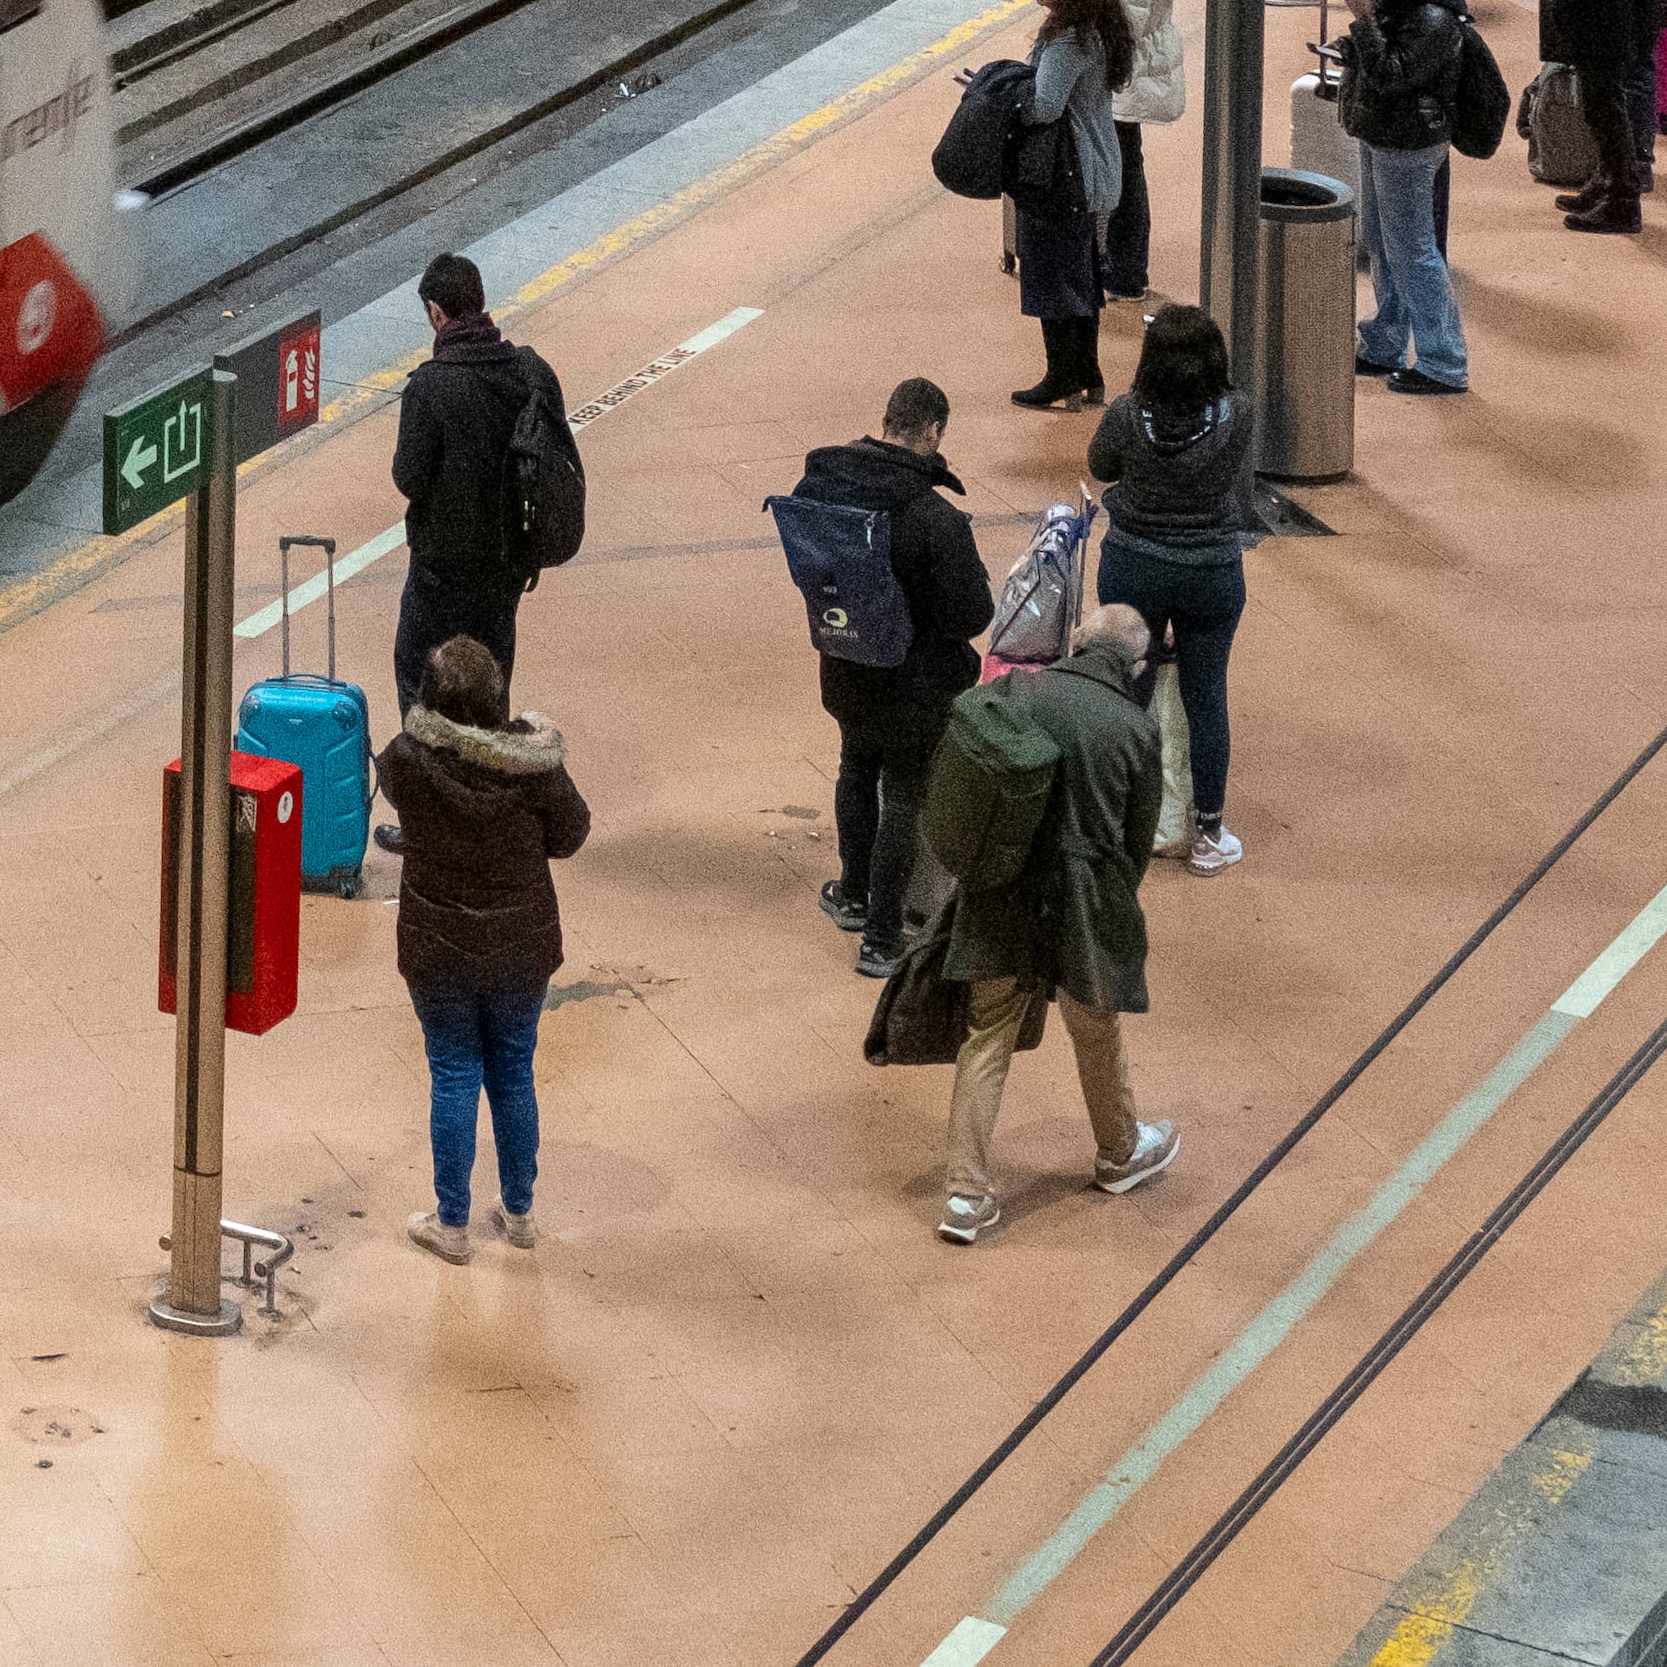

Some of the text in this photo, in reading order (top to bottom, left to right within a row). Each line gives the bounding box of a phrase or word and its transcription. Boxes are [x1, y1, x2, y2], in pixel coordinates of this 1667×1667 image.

[569, 347, 697, 426] KEEP BEHIND THE LINE
